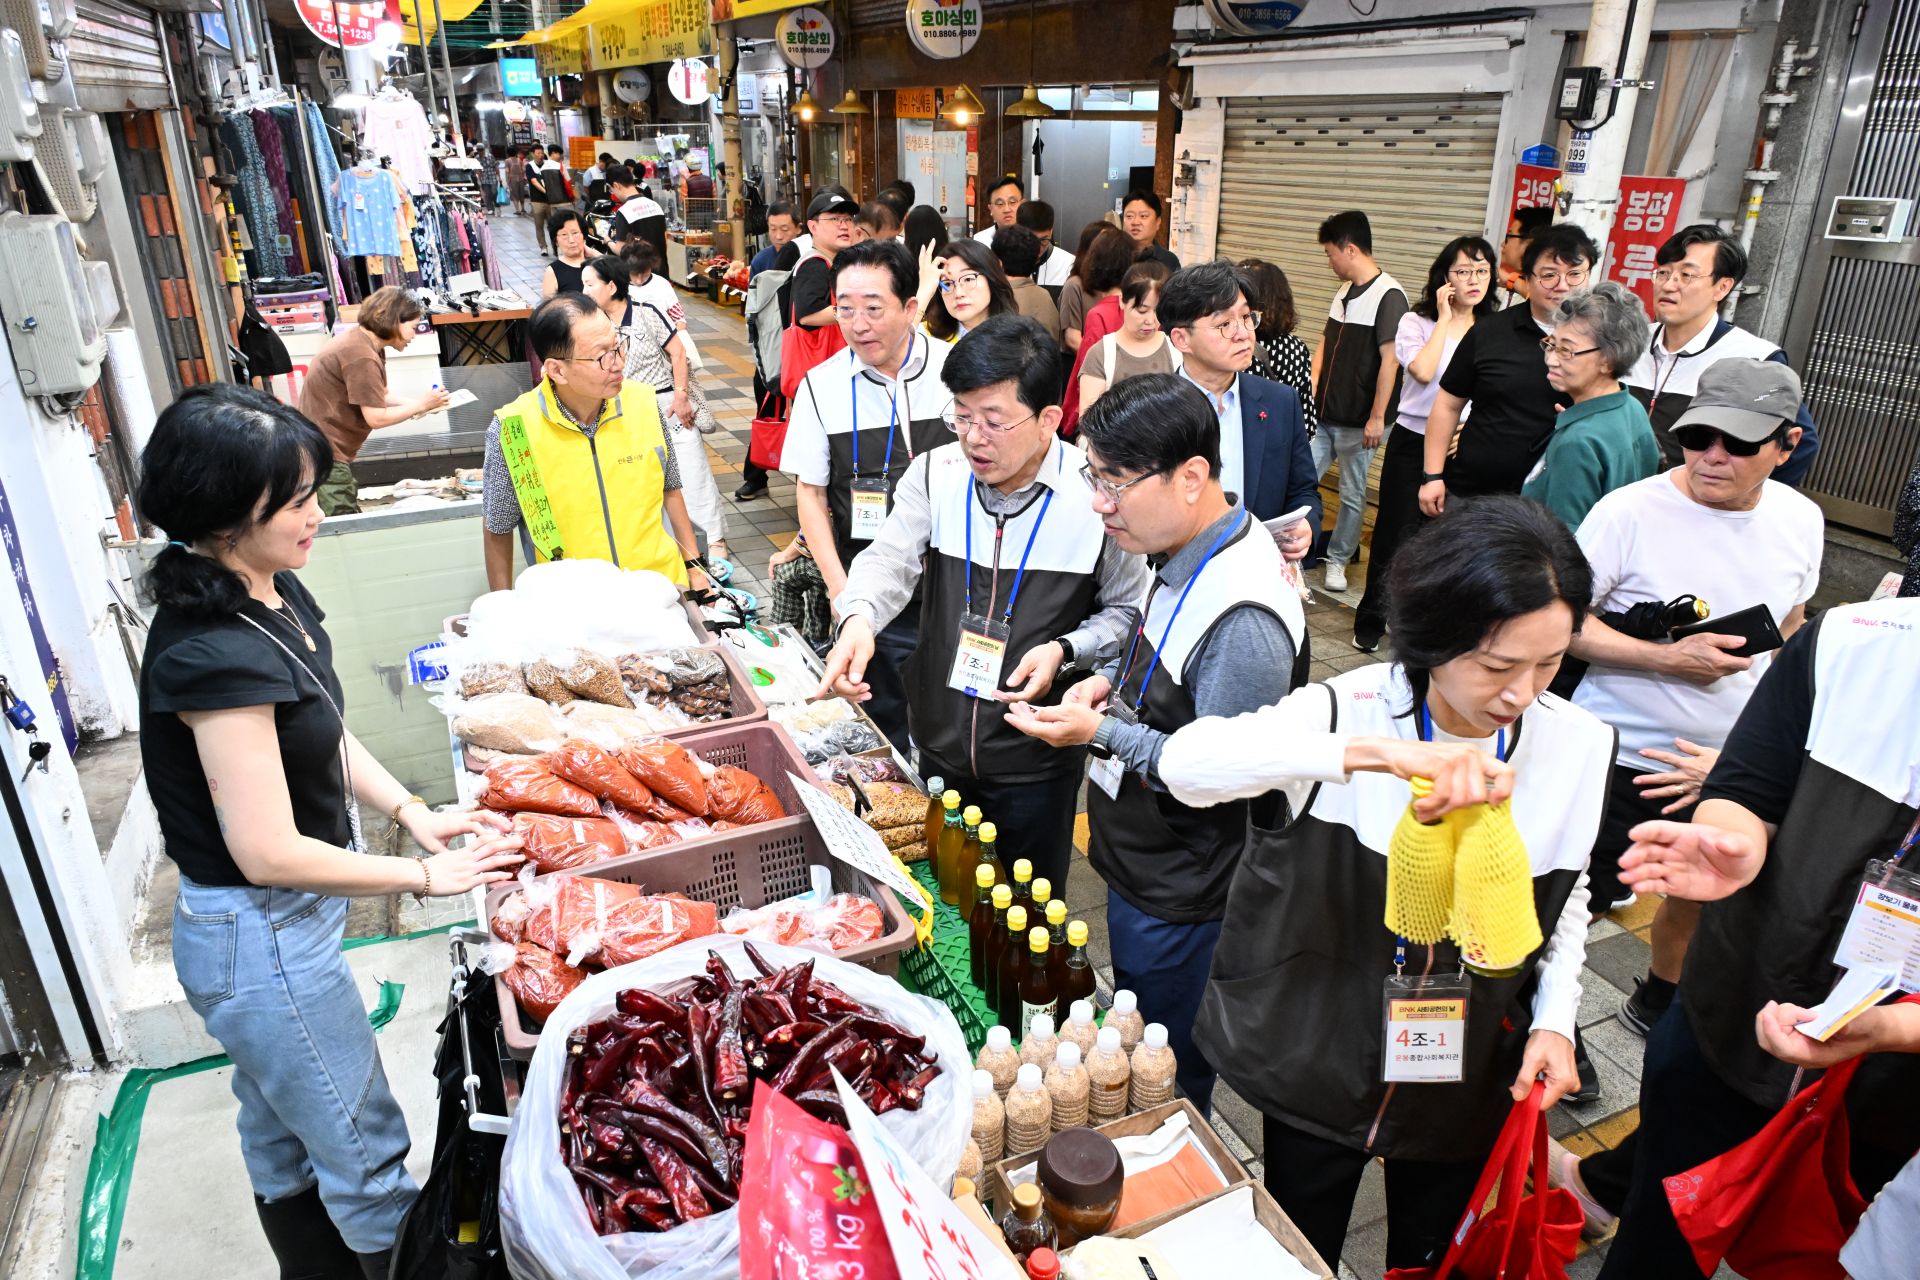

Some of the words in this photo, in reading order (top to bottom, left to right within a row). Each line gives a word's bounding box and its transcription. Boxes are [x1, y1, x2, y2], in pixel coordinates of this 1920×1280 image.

[1567, 148, 1585, 161] 099
[1623, 189, 1674, 233] 봉평
[856, 507, 878, 520] 7조-1
[1852, 616, 1878, 627] BNK
[962, 651, 991, 673] 7조-1
[1353, 692, 1376, 700] BNK
[1877, 892, 1902, 906] 장보기
[1395, 1029, 1447, 1047] 4조-1
[811, 1227, 827, 1258] 100
